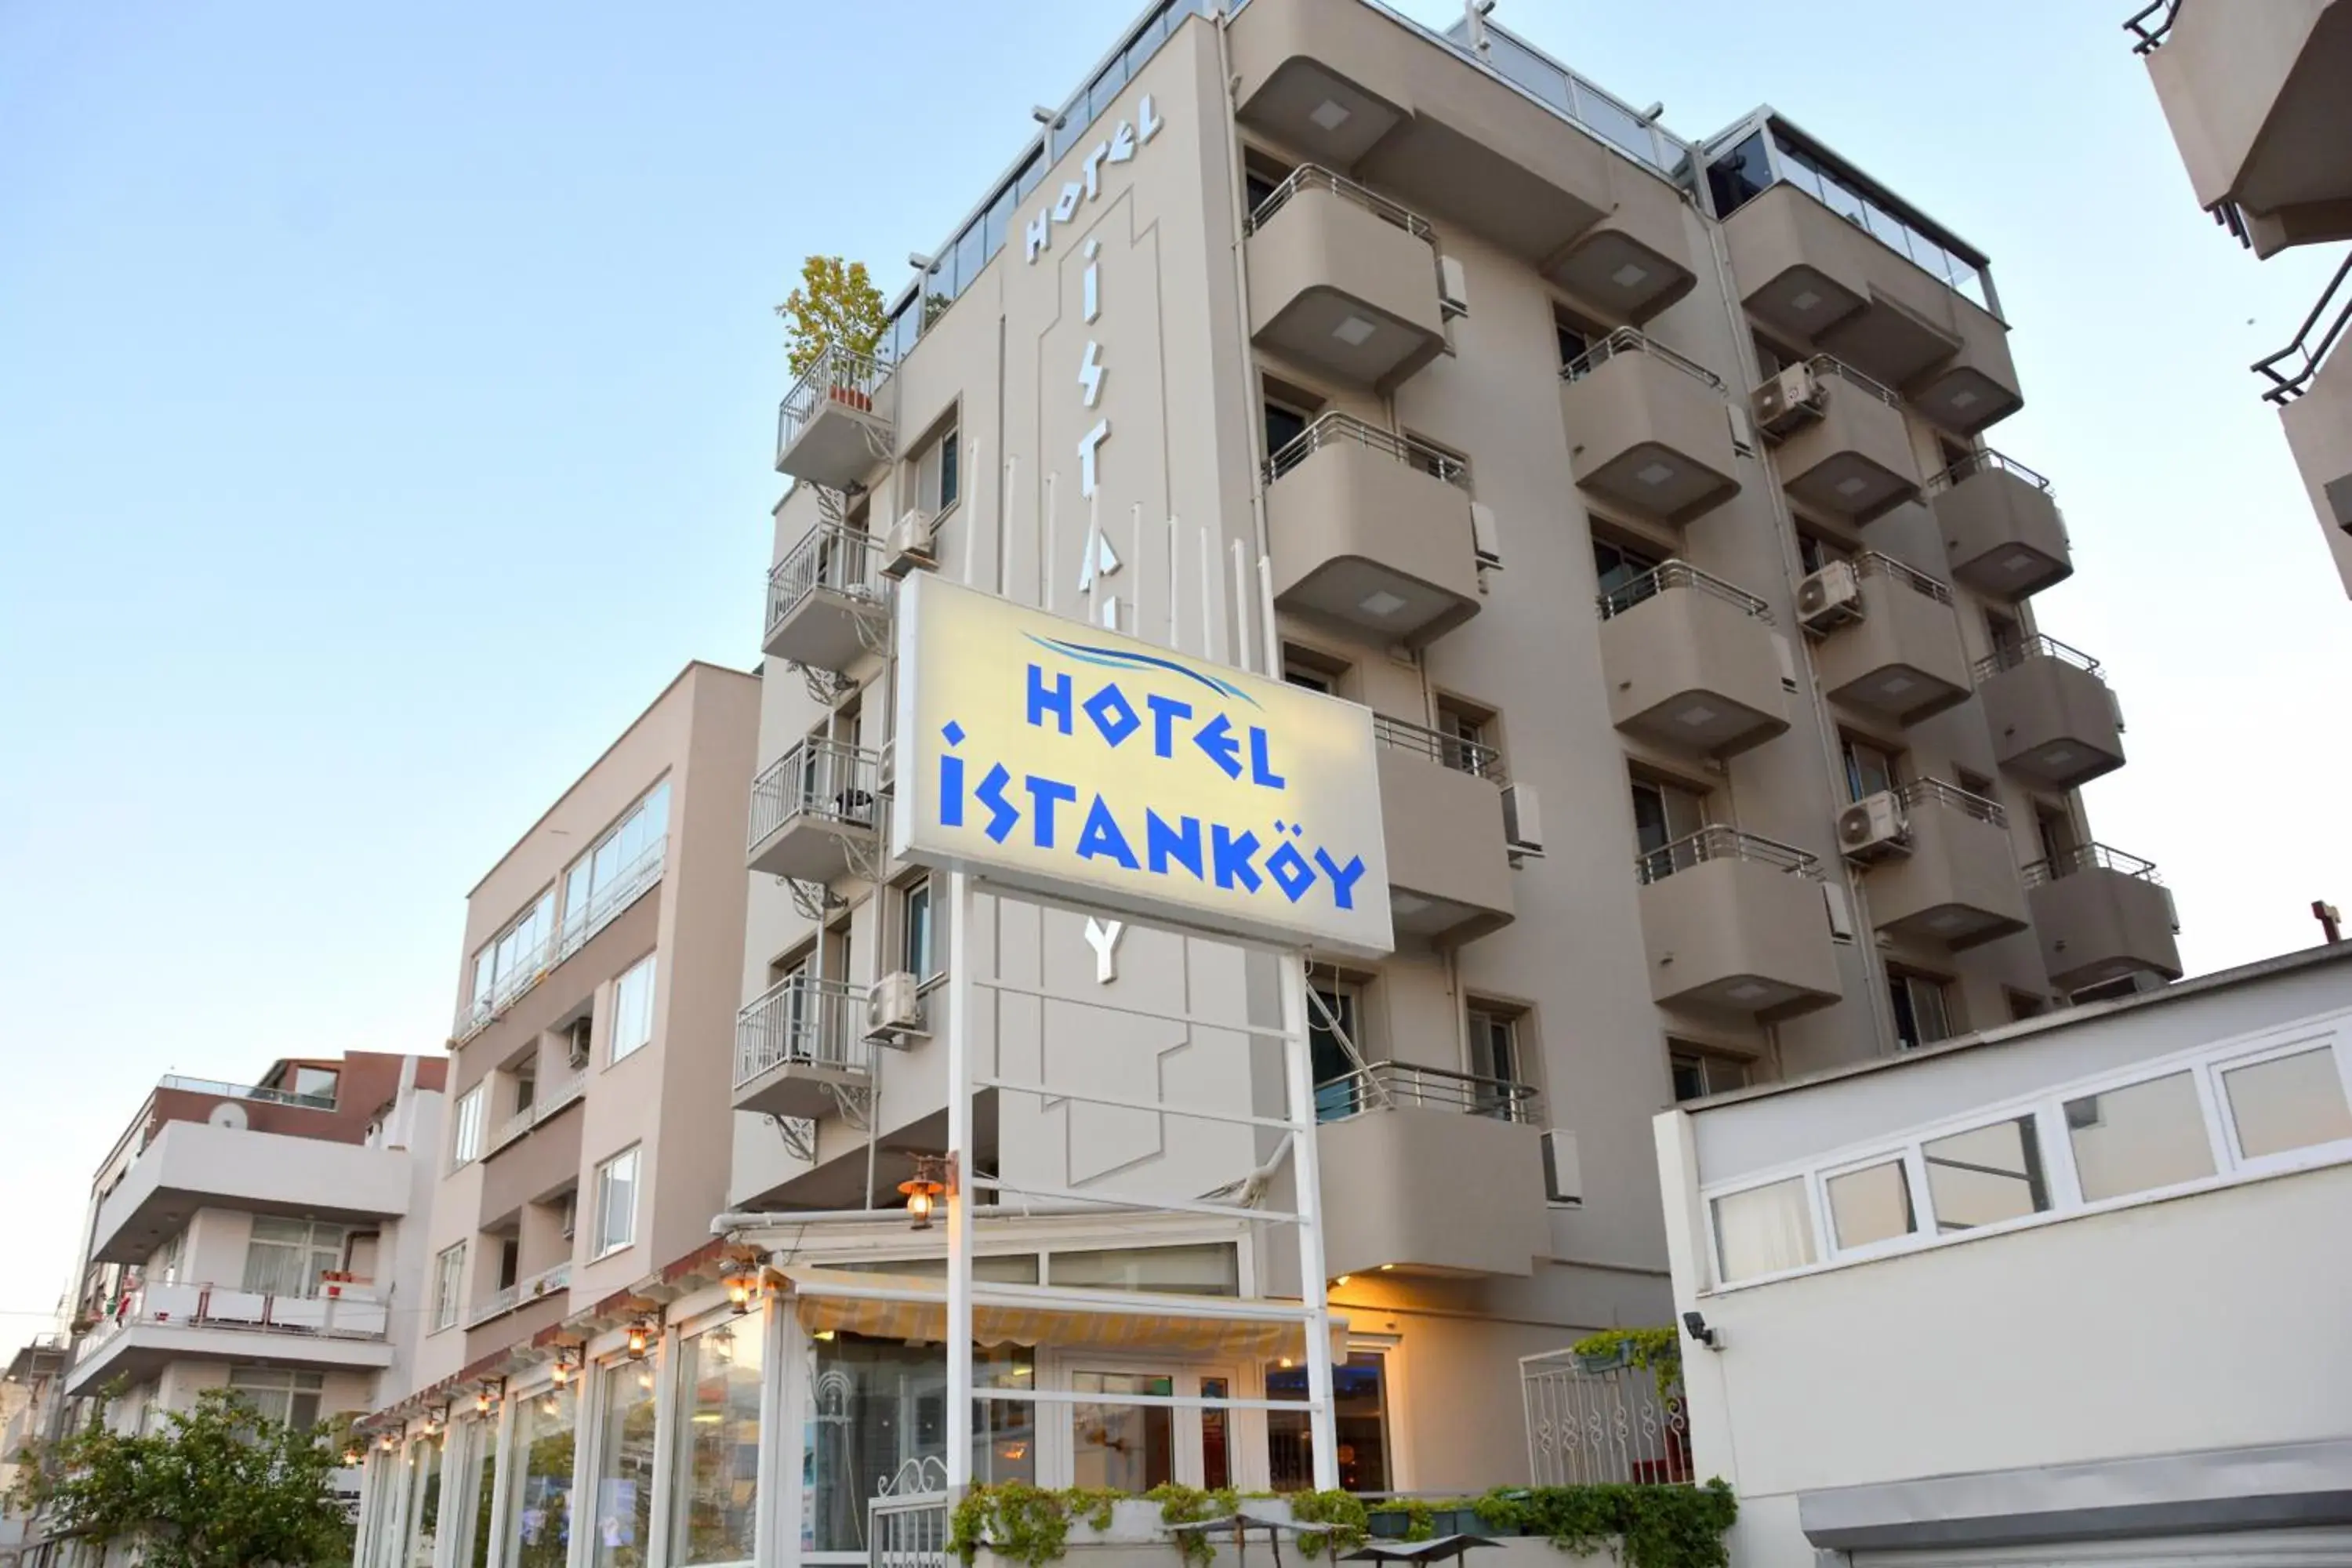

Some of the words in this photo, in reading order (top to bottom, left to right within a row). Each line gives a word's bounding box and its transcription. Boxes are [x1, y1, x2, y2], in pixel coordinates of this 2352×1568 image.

[1026, 93, 1163, 265] HOTEL
[1027, 664, 1285, 789] HOTEL
[940, 720, 1366, 909] İSTANKÖY
